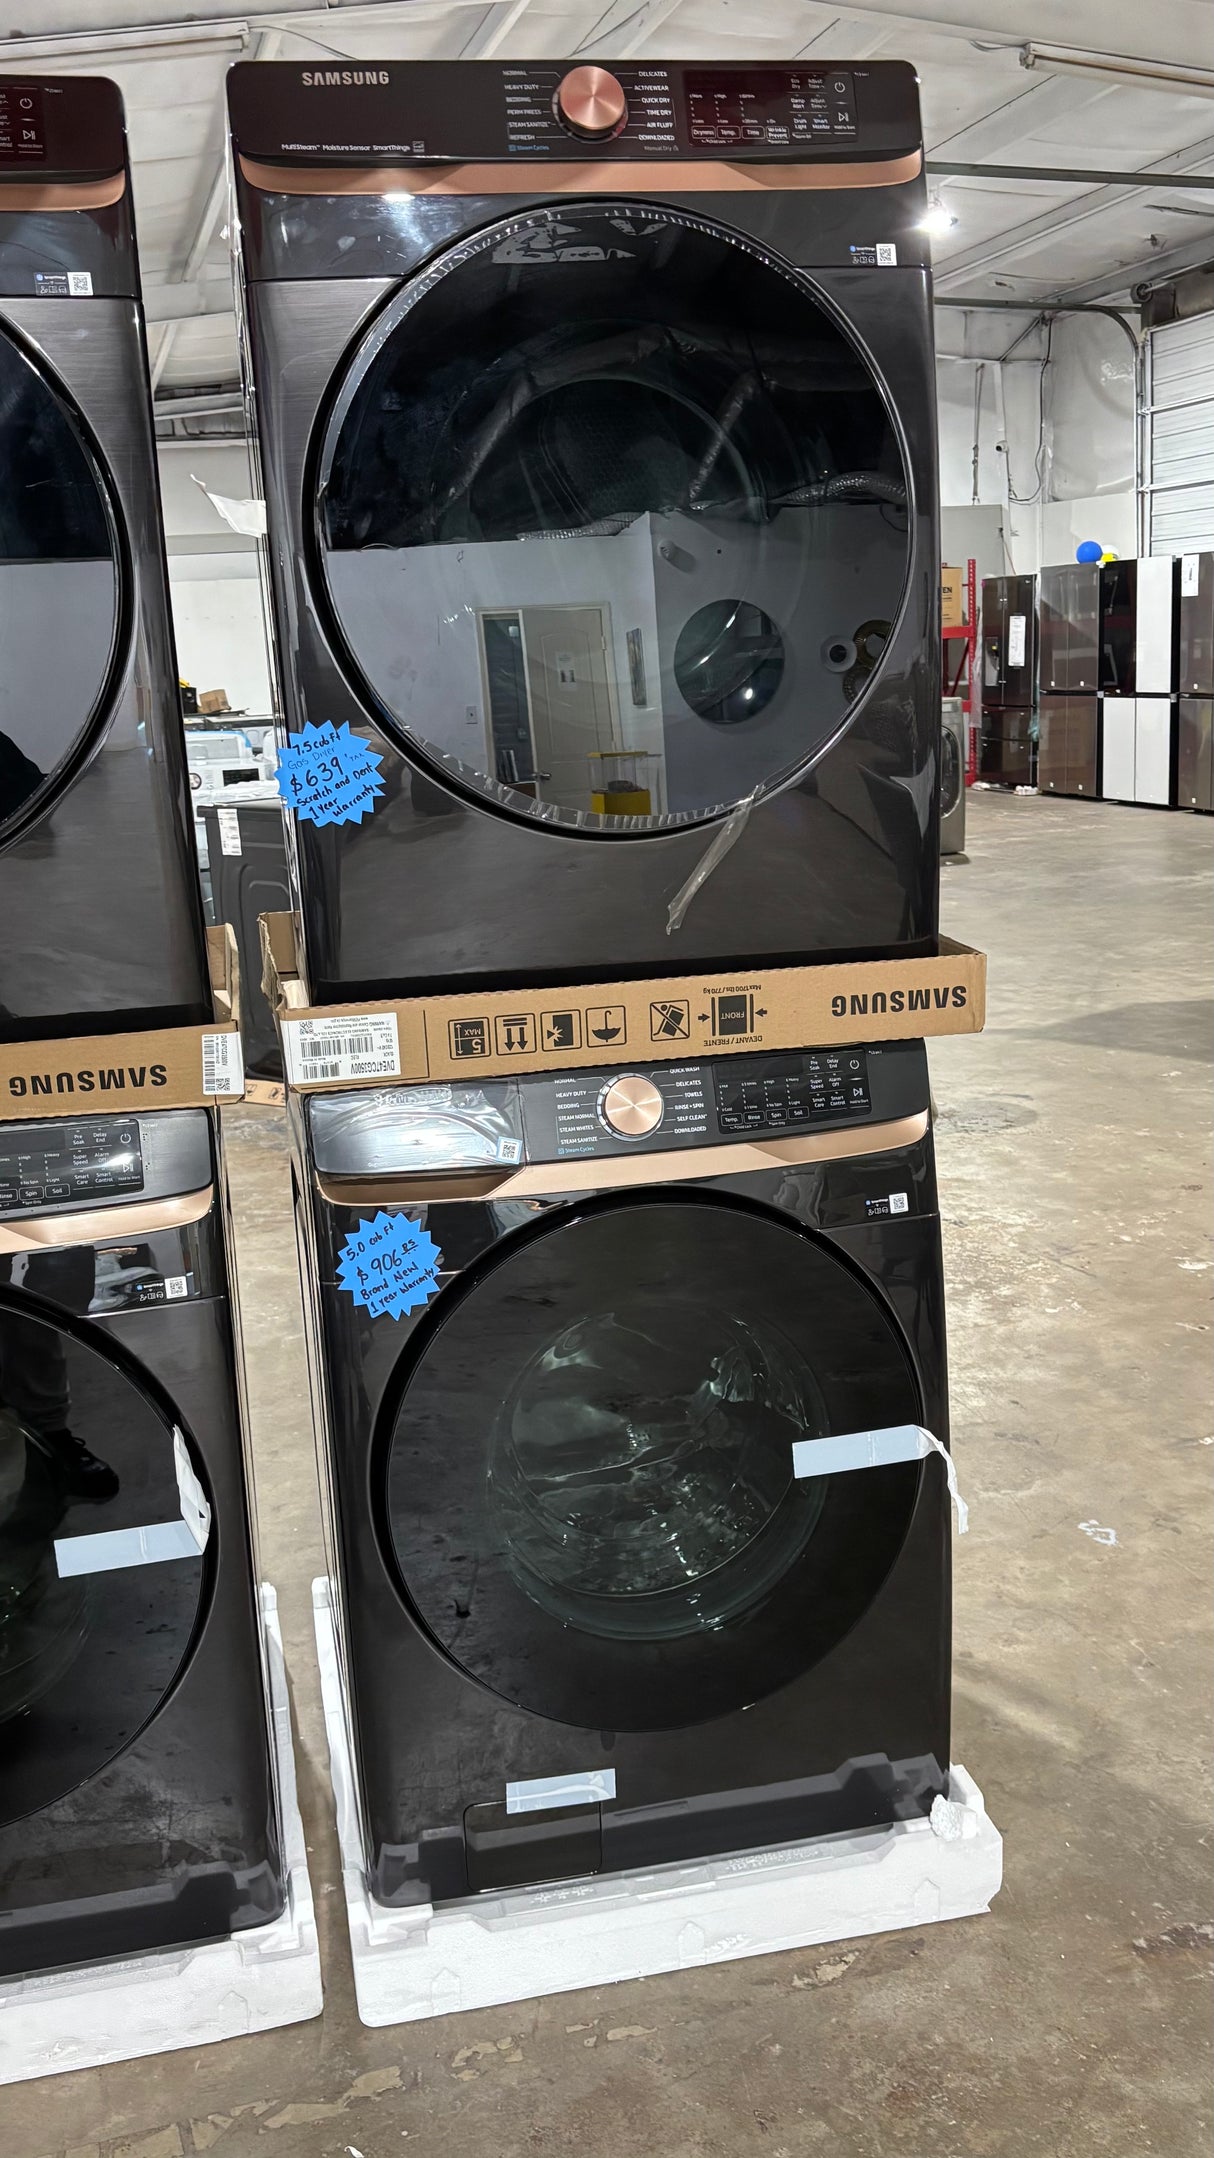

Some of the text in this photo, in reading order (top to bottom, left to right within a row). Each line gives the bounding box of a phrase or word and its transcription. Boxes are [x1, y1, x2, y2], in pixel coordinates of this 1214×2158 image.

[302, 71, 390, 86] SAMSUNG
[293, 740, 313, 756] 7.5
[287, 758, 309, 771] Gas
[335, 775, 350, 789] and
[353, 762, 374, 780] Dent
[831, 985, 968, 1018] SAMSUNG
[721, 1011, 745, 1020] FRONT
[464, 1028, 481, 1036] MAX
[471, 1038, 482, 1053] 5
[703, 1038, 730, 1046] FRENTE
[736, 1035, 763, 1044] DEVANT
[9, 1064, 168, 1097] SAMSUNG
[557, 1102, 580, 1110] BEDDING
[674, 1126, 707, 1134] DOWNLOADED
[360, 1261, 419, 1300] Brand New
[370, 1301, 379, 1313] 1
